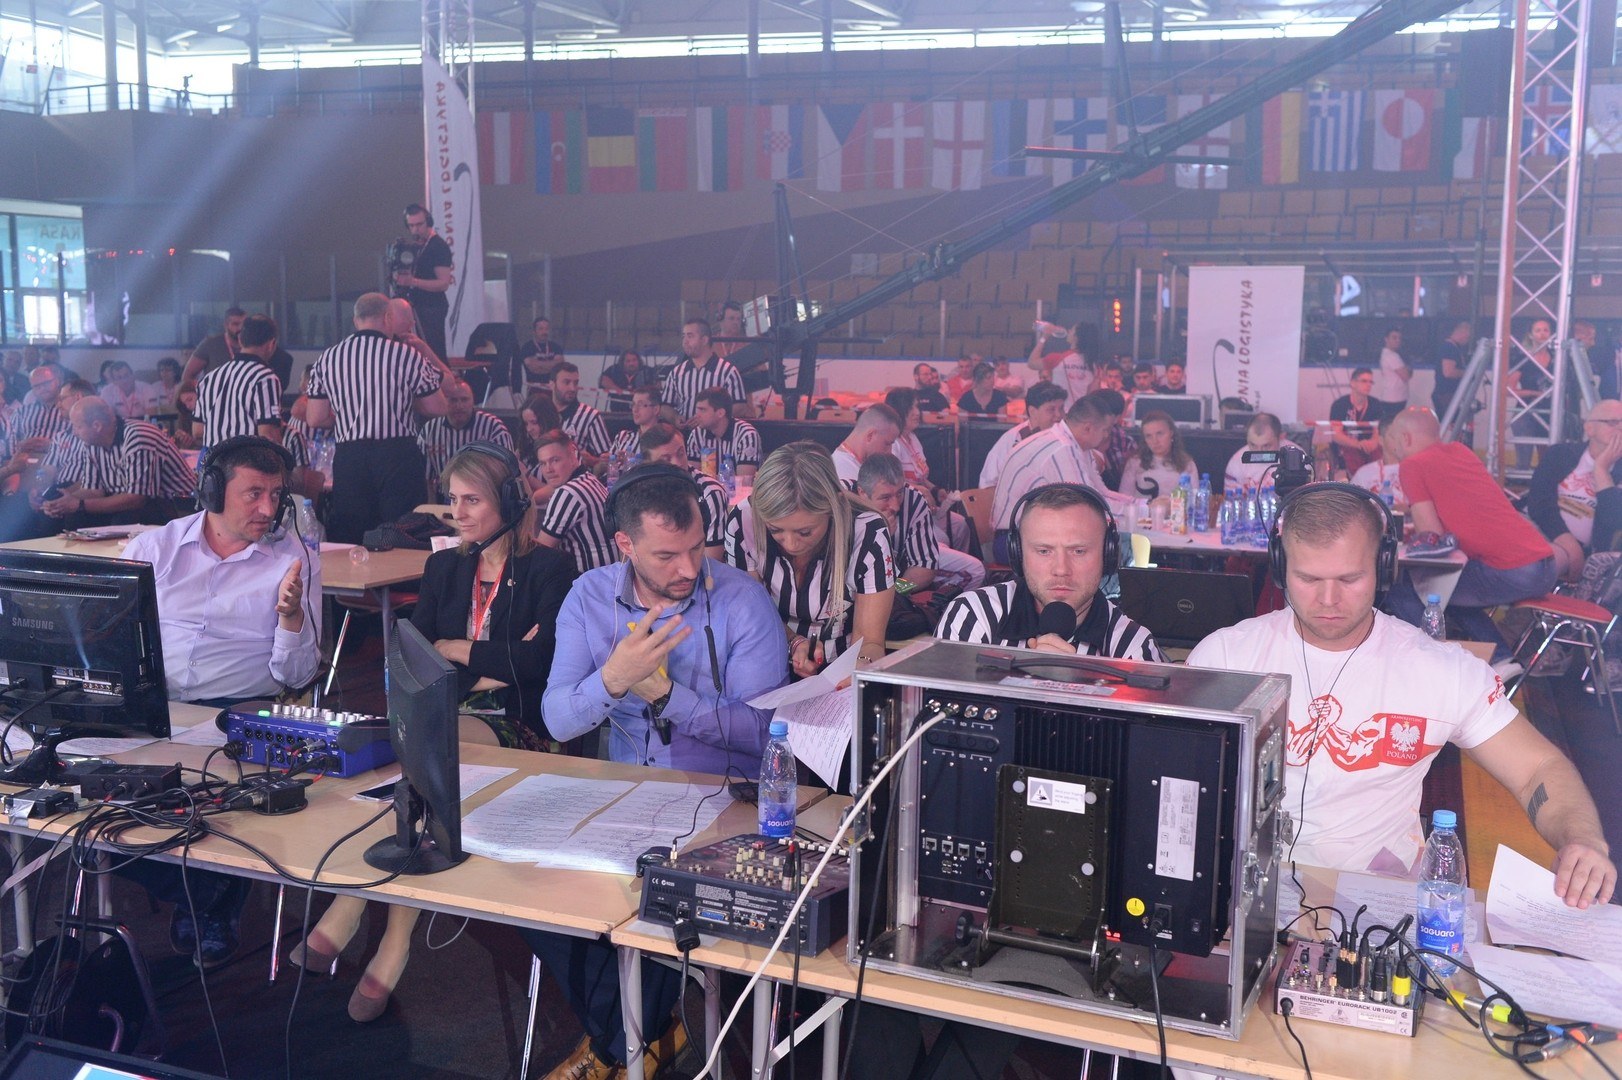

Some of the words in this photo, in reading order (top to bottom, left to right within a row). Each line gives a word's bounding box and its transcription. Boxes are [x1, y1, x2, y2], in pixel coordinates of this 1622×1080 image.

[1238, 279, 1254, 365] LOGISTYKA
[12, 617, 54, 630] SAMSUNG
[1386, 751, 1417, 760] POLAND
[1300, 995, 1334, 1006] BEHRINGER
[1338, 1002, 1371, 1011] EURORACK
